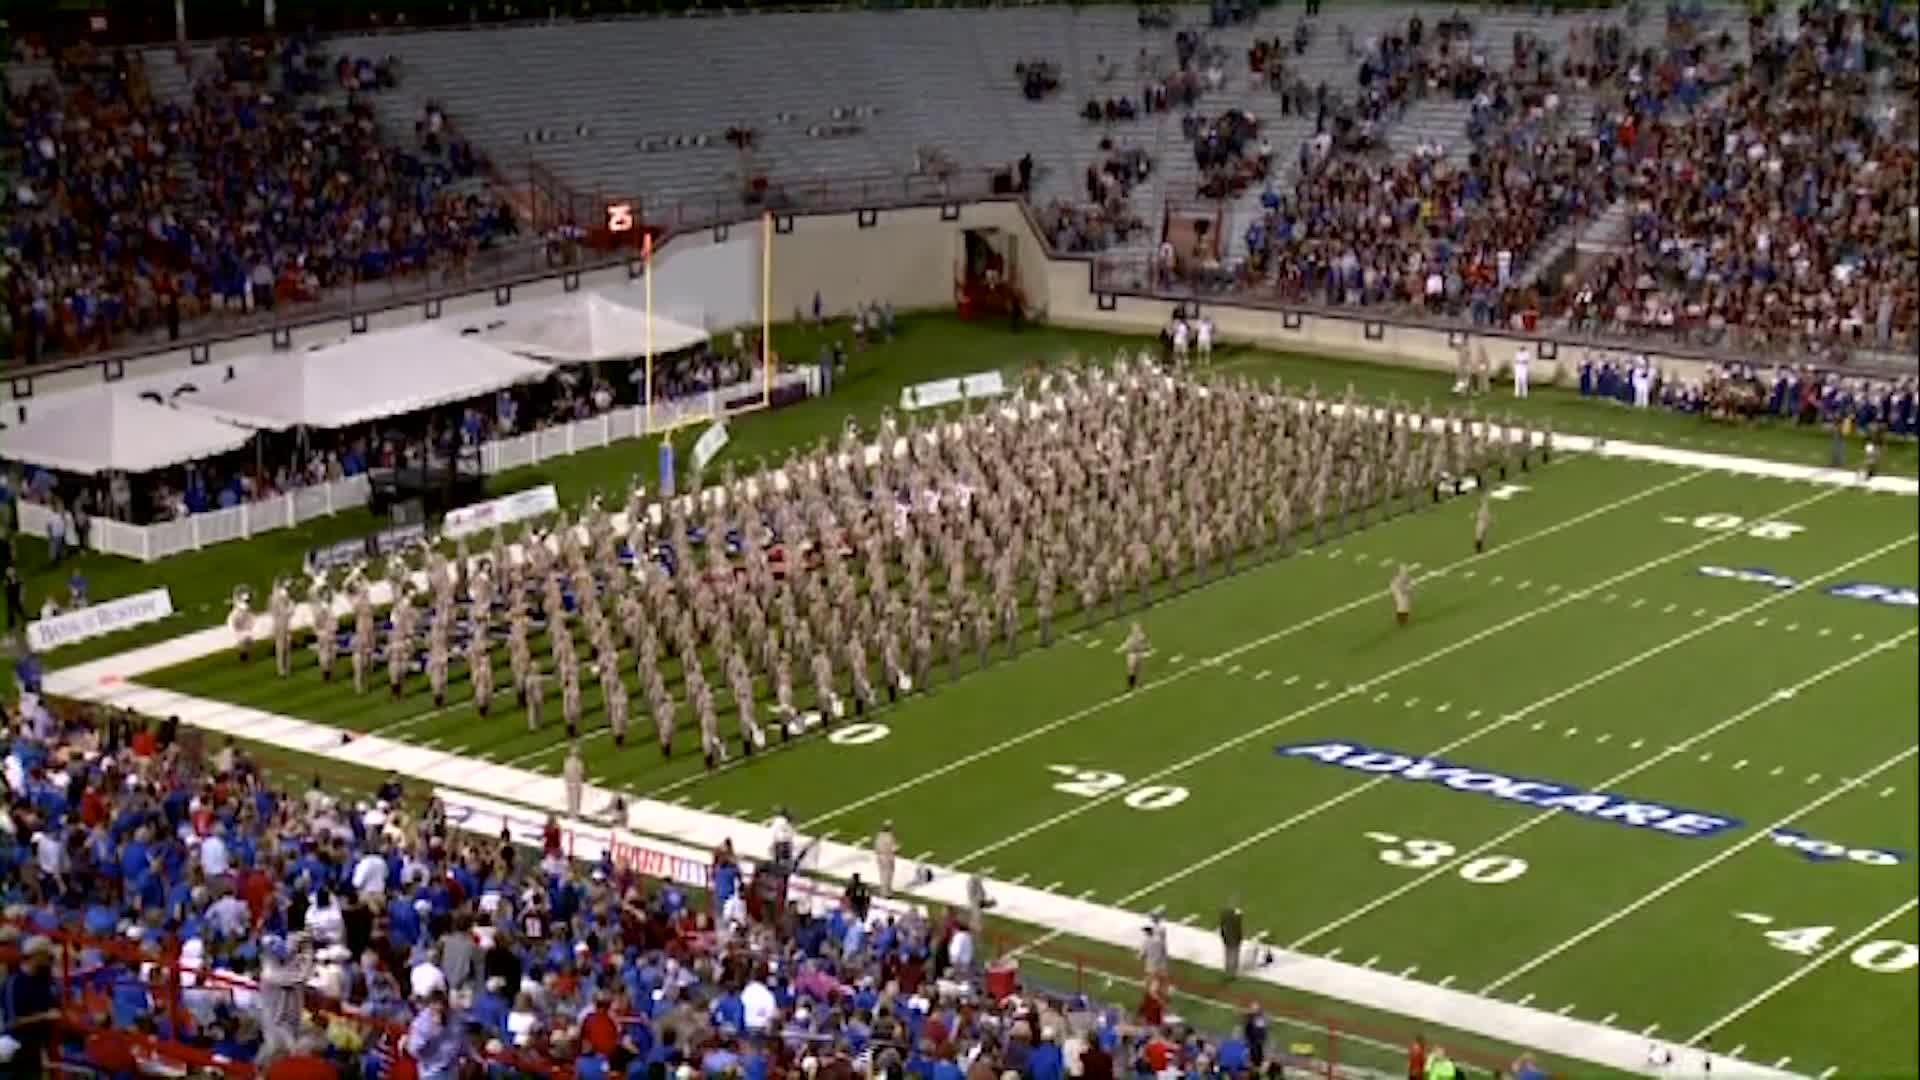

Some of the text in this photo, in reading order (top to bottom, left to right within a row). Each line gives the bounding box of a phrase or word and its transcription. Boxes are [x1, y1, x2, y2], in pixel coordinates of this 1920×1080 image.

[1051, 770, 1190, 810] 20
[1378, 839, 1528, 884] 30
[1762, 925, 1919, 972] 40
